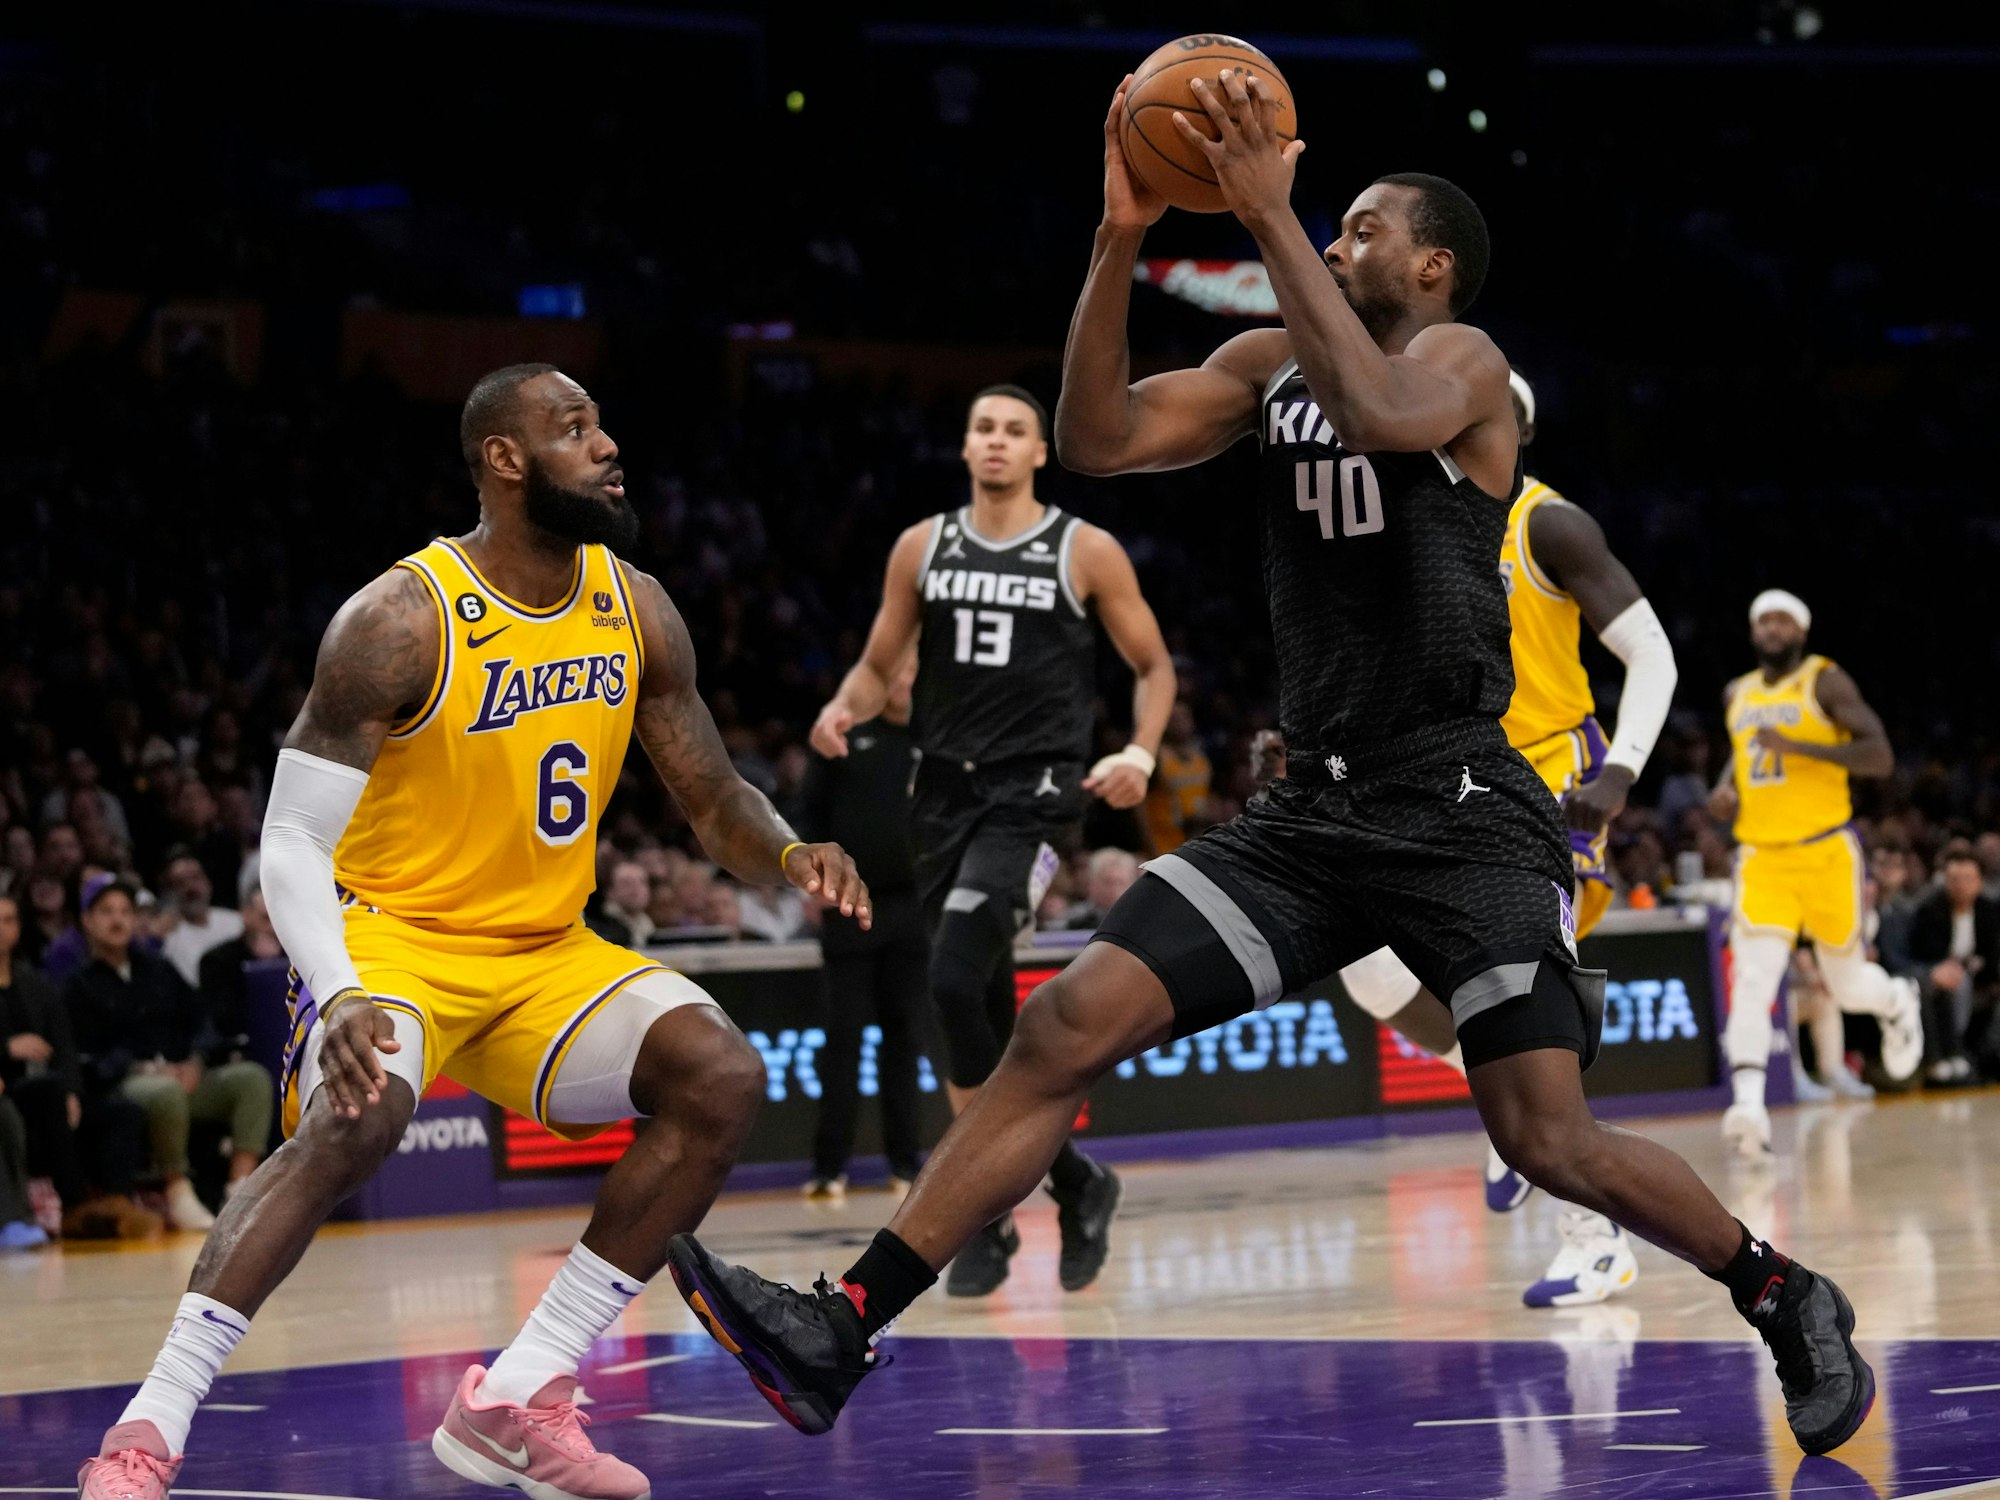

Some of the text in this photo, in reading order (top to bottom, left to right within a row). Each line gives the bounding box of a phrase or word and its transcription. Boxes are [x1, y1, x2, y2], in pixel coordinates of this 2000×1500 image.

[1295, 454, 1385, 540] 40
[461, 596, 482, 619] 6
[925, 569, 1057, 611] KINGS
[591, 614, 627, 631] bibigo
[953, 608, 1014, 667] 13
[465, 652, 629, 735] LAKERS
[535, 740, 590, 847] 6
[396, 1116, 489, 1154] OYOTA
